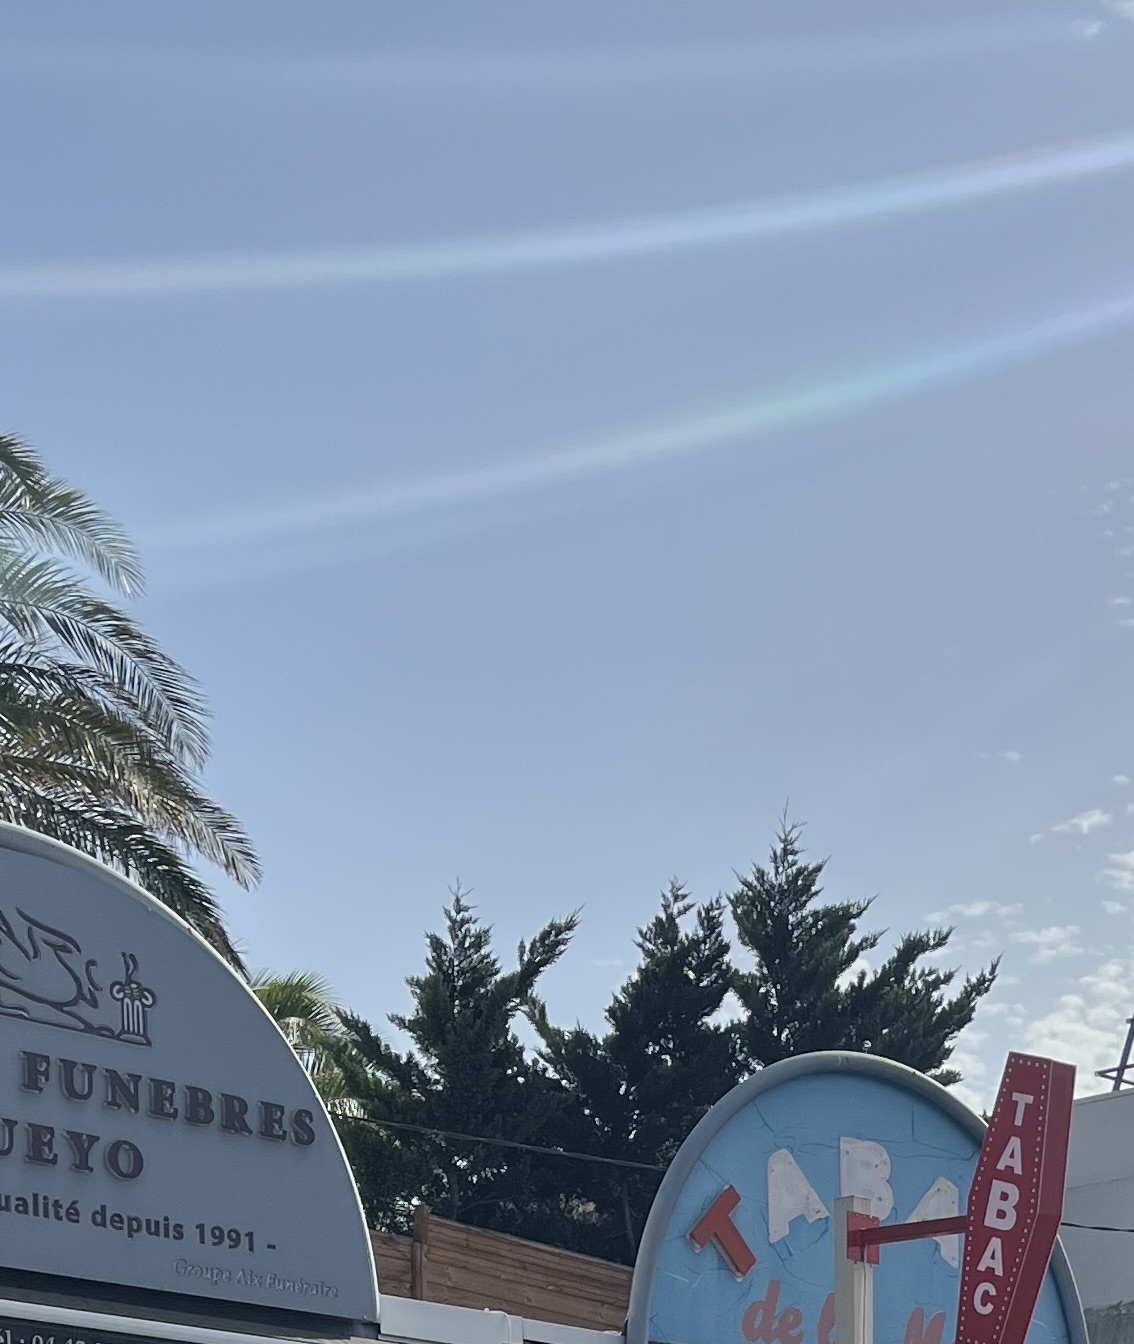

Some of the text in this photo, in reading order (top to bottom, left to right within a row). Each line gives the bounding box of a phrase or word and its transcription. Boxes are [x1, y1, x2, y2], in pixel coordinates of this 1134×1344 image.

[22, 1051, 316, 1147] FUNEBRES
[91, 1204, 185, 1241] depuis
[195, 1222, 255, 1252] 1991
[689, 1136, 960, 1282] TABA
[972, 1092, 1034, 1315] TABAC
[173, 1258, 339, 1299] Groupe Aix Funéraire
